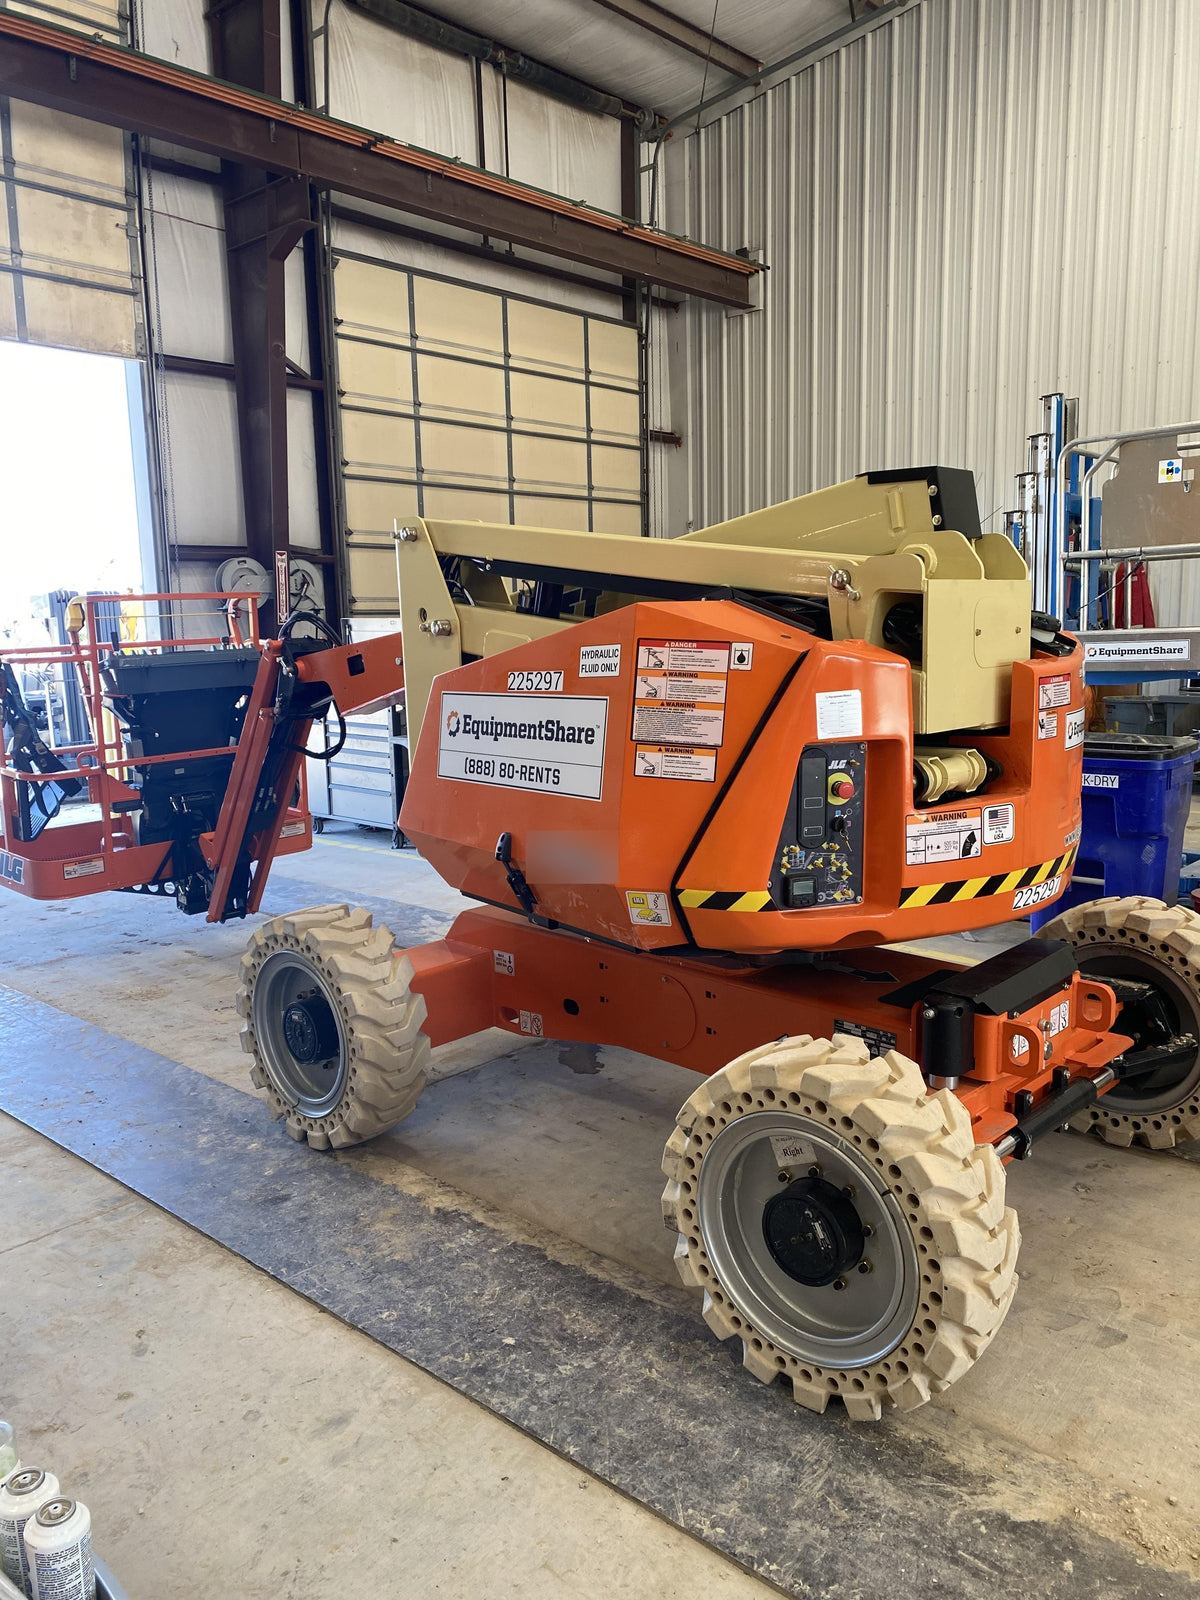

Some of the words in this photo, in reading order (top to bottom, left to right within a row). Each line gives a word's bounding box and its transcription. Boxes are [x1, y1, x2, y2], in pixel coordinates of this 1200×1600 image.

[581, 648, 619, 660] HYDRAULIC
[1098, 646, 1184, 658] EquipmentShare
[580, 663, 599, 673] FLUID
[600, 662, 618, 672] ONLY
[507, 671, 562, 691] 225297
[668, 671, 698, 679] WARNING
[666, 701, 696, 709] WARNING
[462, 714, 595, 745] EquipmentShare
[664, 747, 695, 755] WARNING
[828, 759, 848, 770] JLG
[464, 756, 495, 778] (888)
[498, 762, 561, 786] 80-RENTS
[1083, 775, 1117, 787] K-DRY
[931, 811, 968, 823] WARNING
[993, 832, 1004, 841] USA
[1012, 874, 1062, 910] 225297
[782, 1146, 804, 1157] Right
